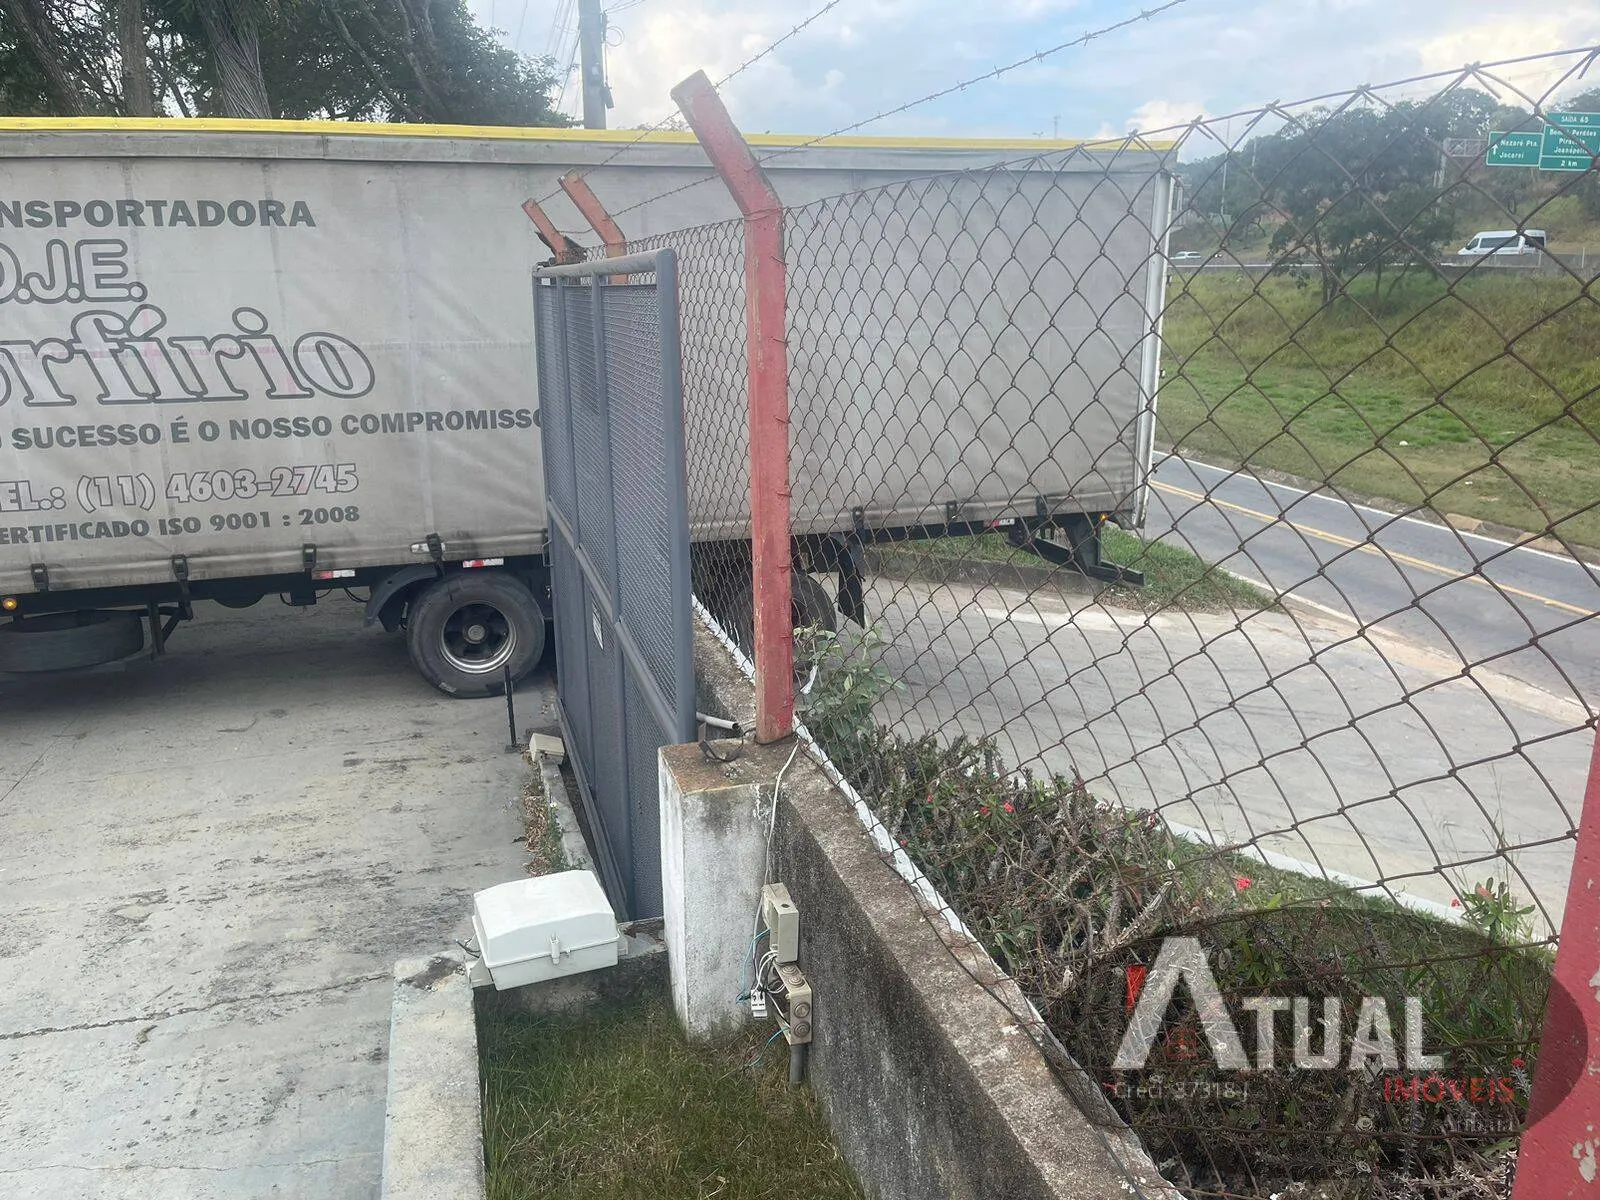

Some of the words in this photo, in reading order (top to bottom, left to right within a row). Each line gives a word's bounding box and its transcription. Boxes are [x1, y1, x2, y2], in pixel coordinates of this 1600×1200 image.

[0, 303, 376, 406] rfírio
[11, 423, 162, 450] SUCESSO
[170, 415, 190, 444] É
[198, 420, 220, 442] O
[229, 415, 332, 441] NOSSO
[77, 473, 156, 513] (11)
[166, 463, 360, 504] 4603-2745
[158, 516, 201, 536] ISO
[209, 511, 271, 532] 9001
[298, 505, 360, 526] 2008
